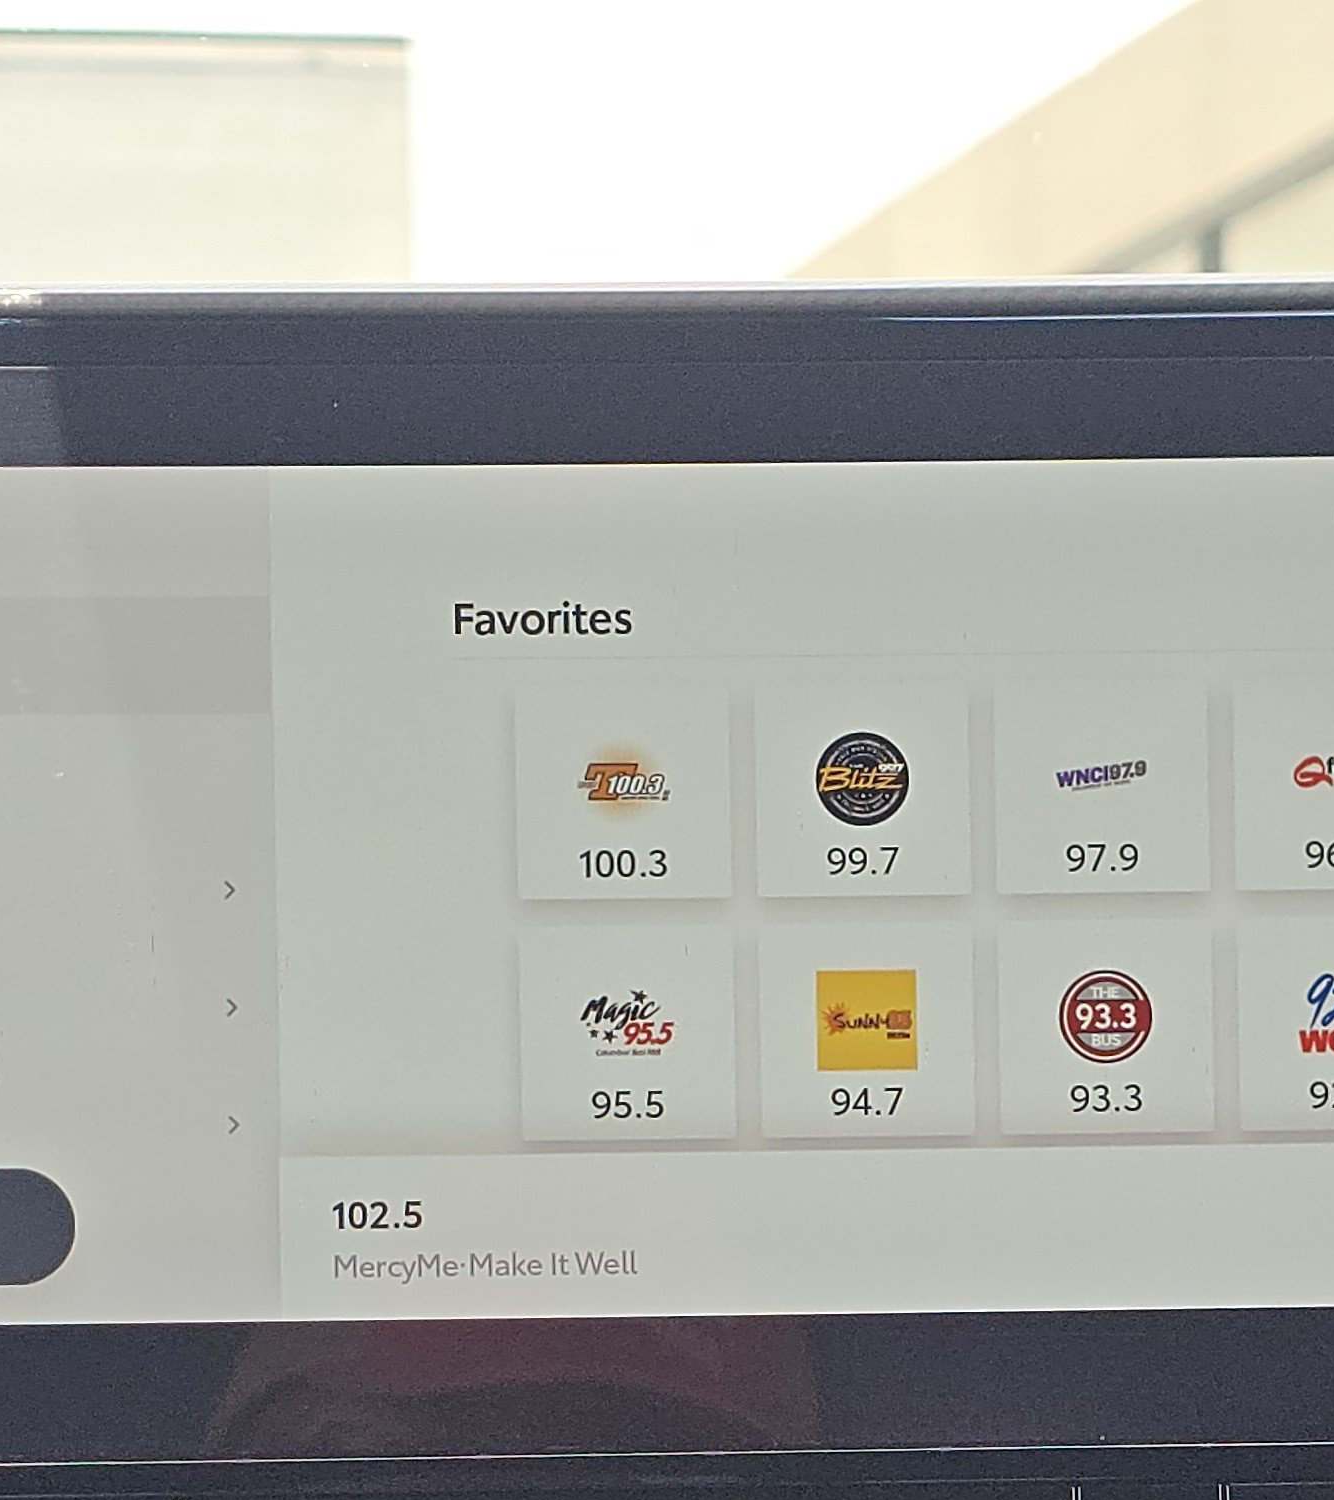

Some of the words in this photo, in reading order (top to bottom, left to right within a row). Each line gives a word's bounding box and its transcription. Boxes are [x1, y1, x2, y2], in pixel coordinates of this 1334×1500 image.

[454, 601, 632, 636] Favorites
[819, 766, 903, 792] Blitz
[580, 849, 667, 878] 100.3
[827, 846, 899, 875] 99.7
[1066, 843, 1138, 872] 97.9
[1090, 987, 1121, 999] THE
[581, 996, 660, 1030] Magic
[1075, 1002, 1138, 1030] 93.3
[1091, 1034, 1121, 1047] BUS
[592, 1090, 664, 1119] 95.5
[831, 1087, 903, 1116] 94.7
[1071, 1084, 1142, 1113] 93.3
[333, 1200, 422, 1230] 102.5
[551, 1250, 568, 1276] It
[574, 1249, 638, 1276] Well
